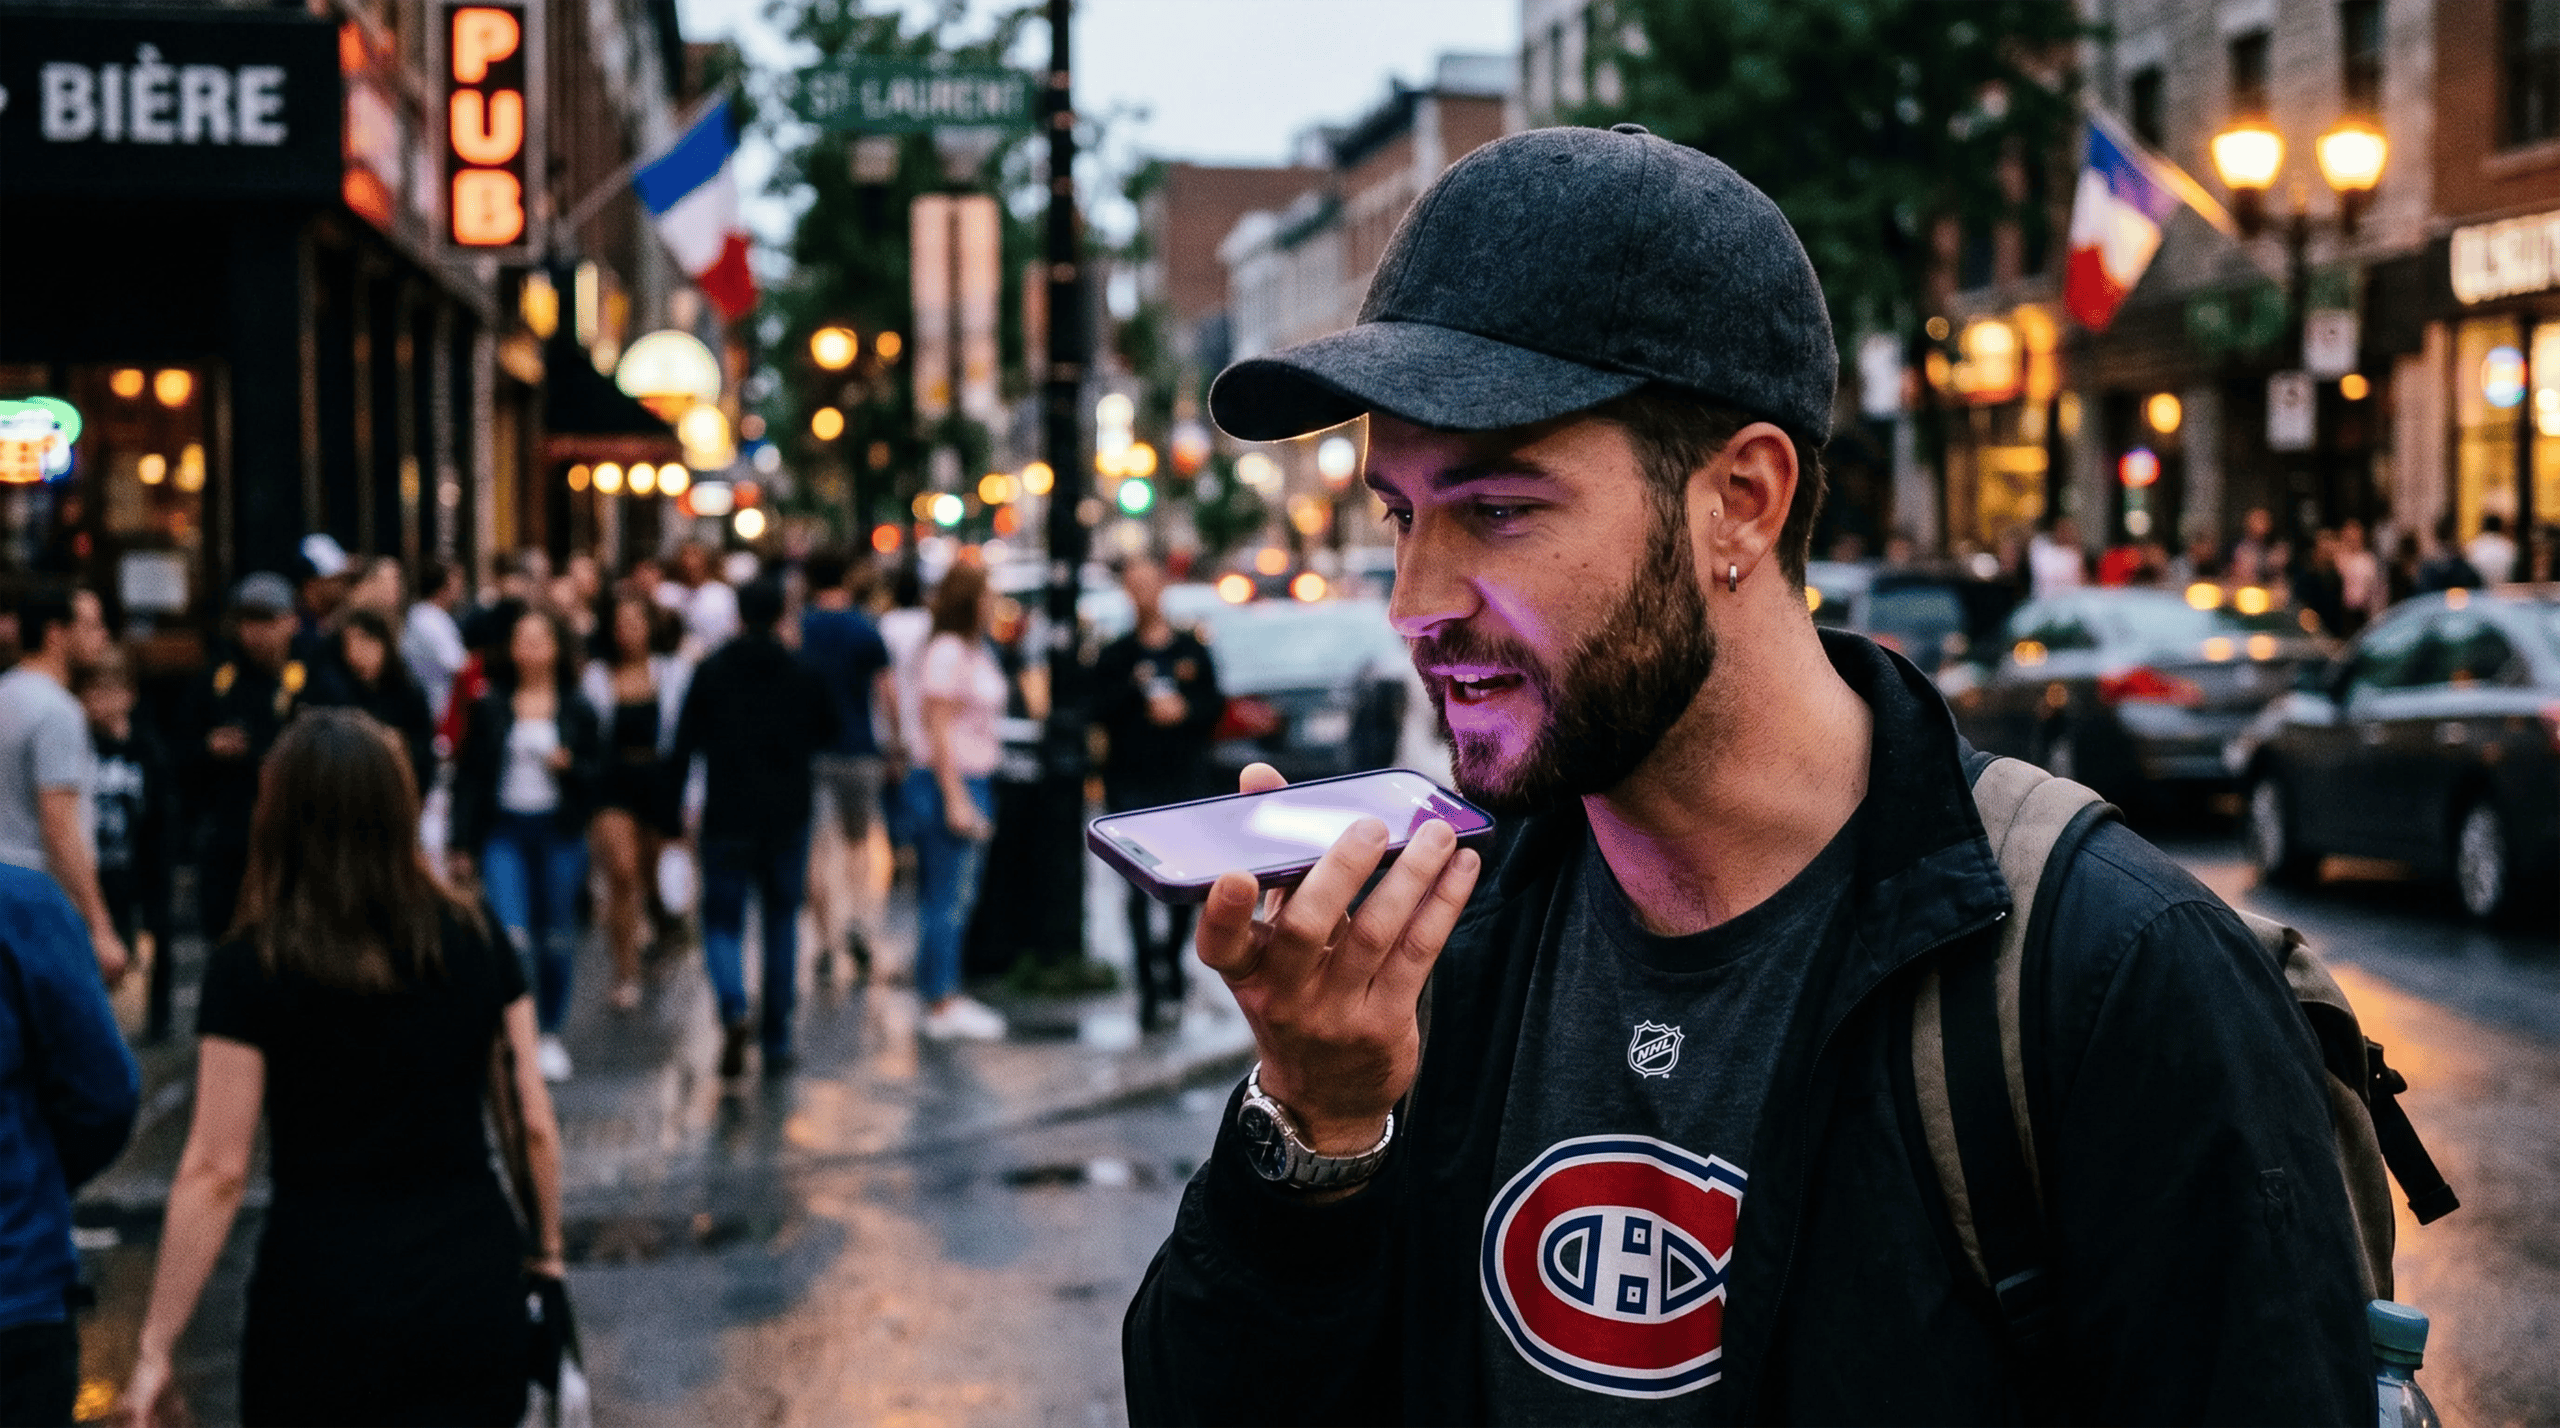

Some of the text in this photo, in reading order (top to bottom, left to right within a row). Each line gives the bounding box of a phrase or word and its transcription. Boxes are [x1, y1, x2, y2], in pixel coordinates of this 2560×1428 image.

[40, 43, 288, 145] BIÈRE
[452, 7, 525, 246] PUB
[860, 76, 1025, 120] LAURENT
[1637, 1038, 1671, 1063] NHL
